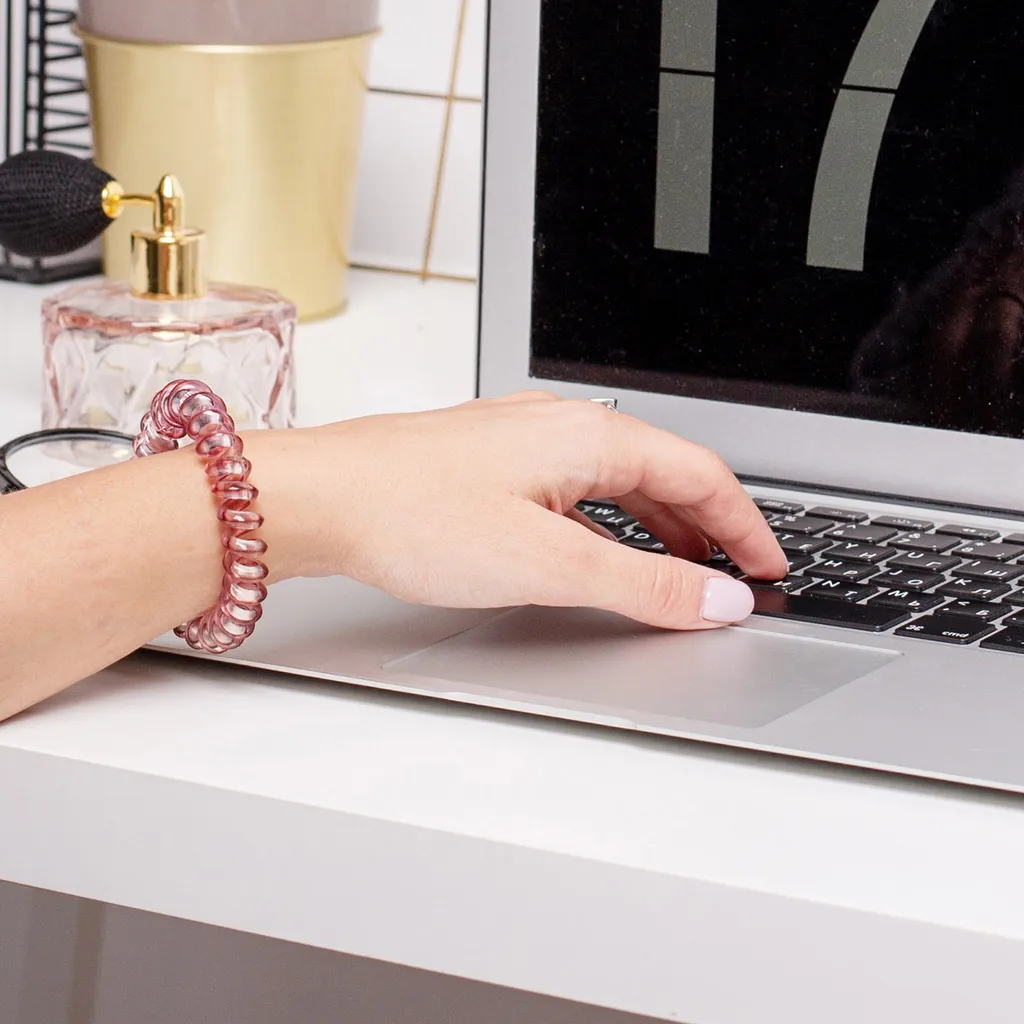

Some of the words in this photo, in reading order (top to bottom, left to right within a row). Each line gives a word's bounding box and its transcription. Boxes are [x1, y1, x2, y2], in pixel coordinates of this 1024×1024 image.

[595, 507, 615, 515] W
[634, 532, 650, 540] D
[824, 560, 842, 568] H
[955, 578, 972, 586] K
[888, 590, 909, 598] M
